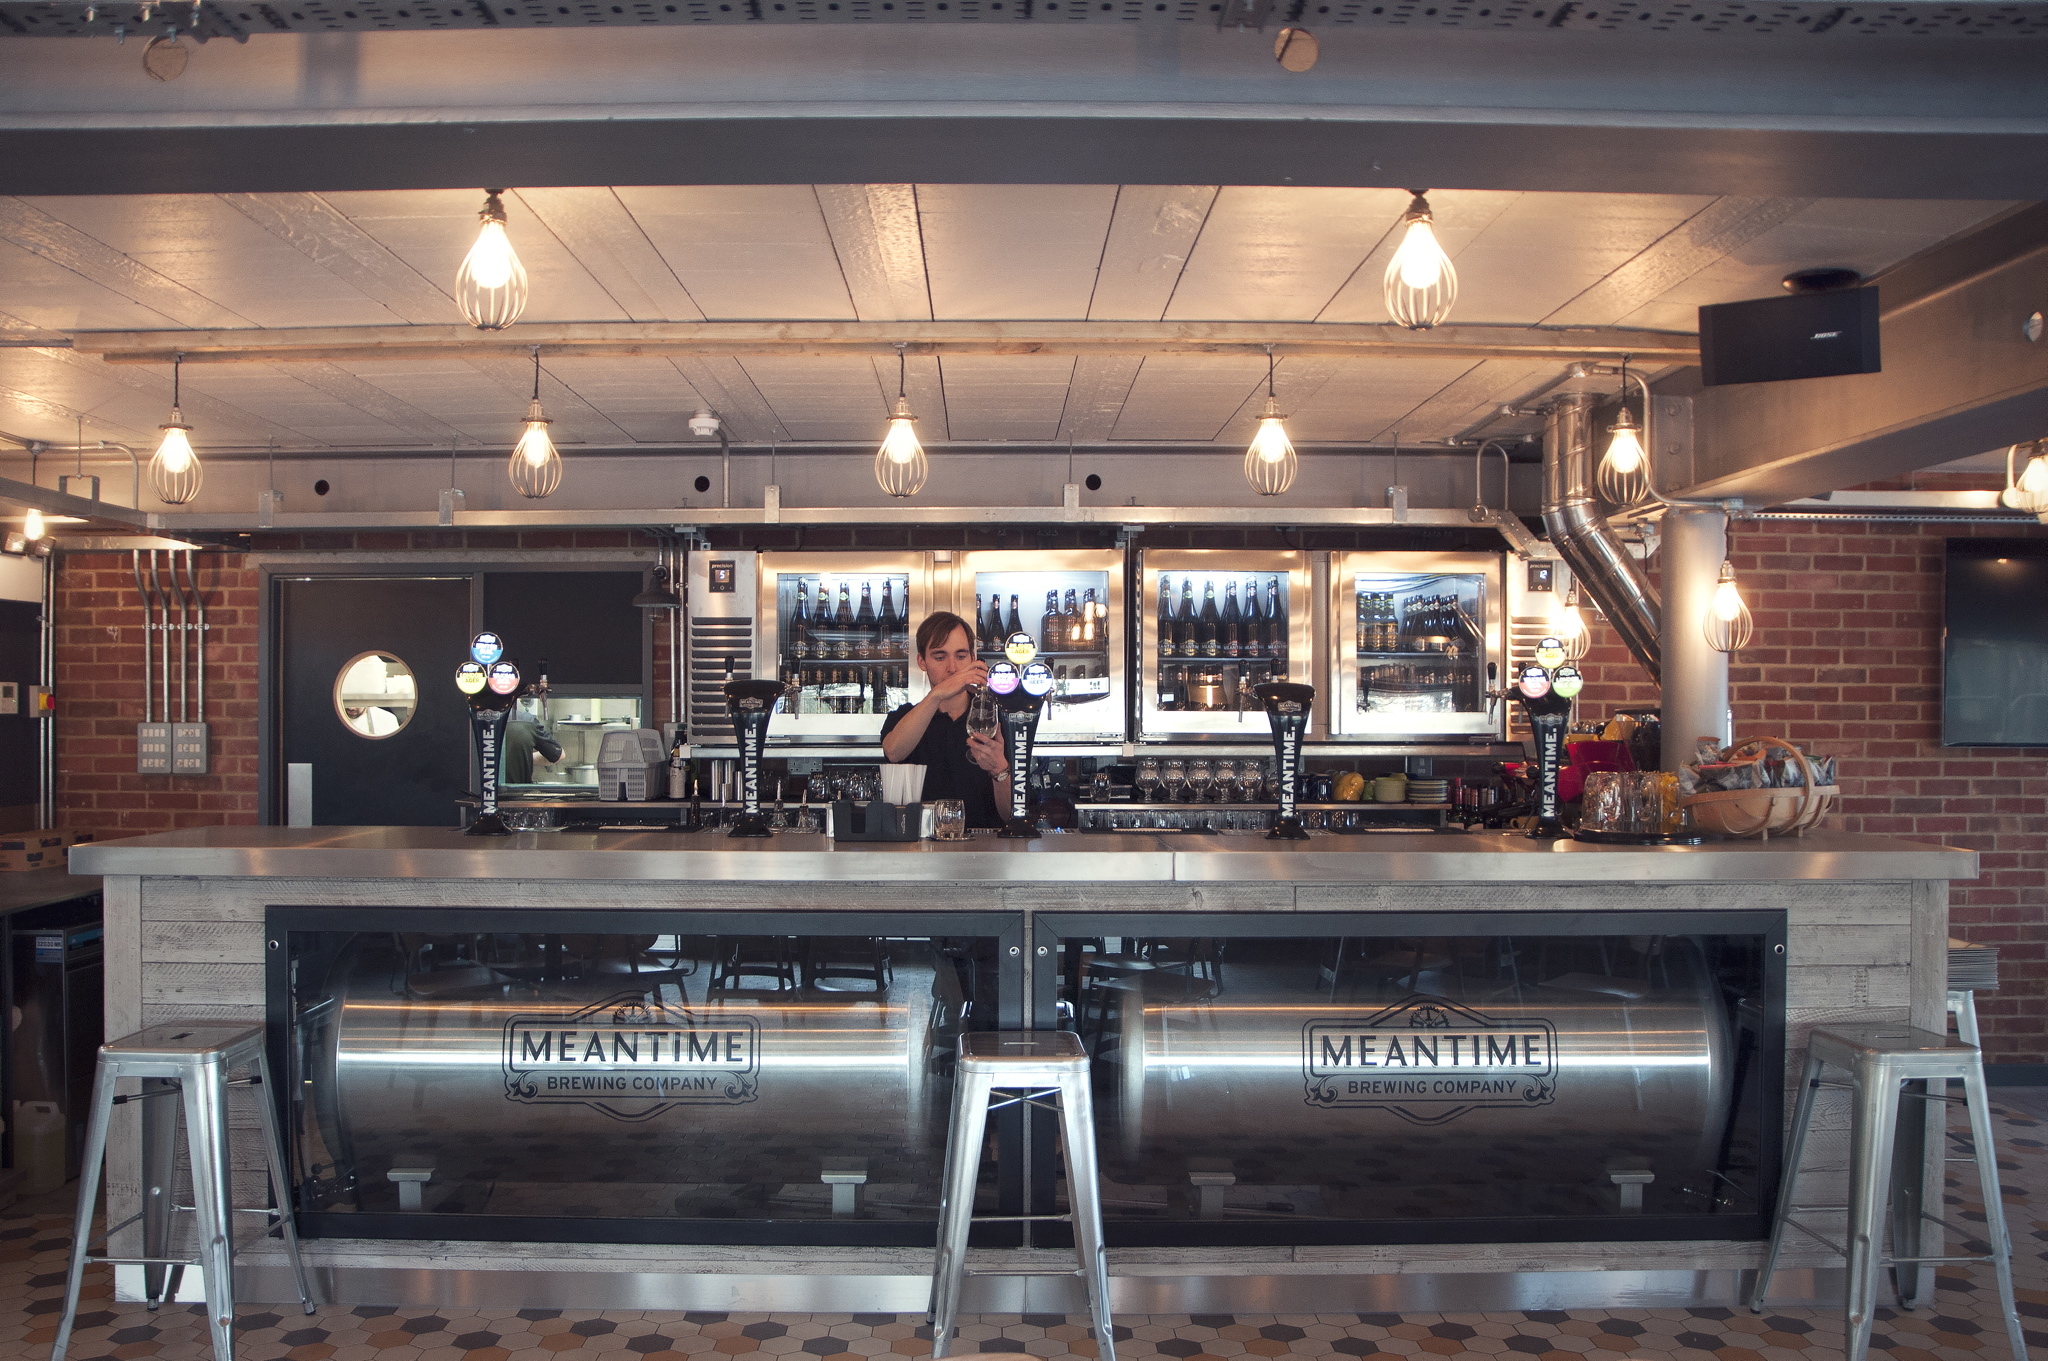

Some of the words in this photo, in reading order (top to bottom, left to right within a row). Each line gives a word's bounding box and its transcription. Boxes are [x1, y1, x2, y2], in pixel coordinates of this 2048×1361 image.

[520, 1030, 744, 1064] MEANTIME
[1321, 1034, 1542, 1067] MEANTIME
[547, 1076, 627, 1090] BREWING
[632, 1076, 718, 1090] COMPANY
[1348, 1080, 1427, 1094] BREWING
[1432, 1080, 1517, 1094] COMPANY
